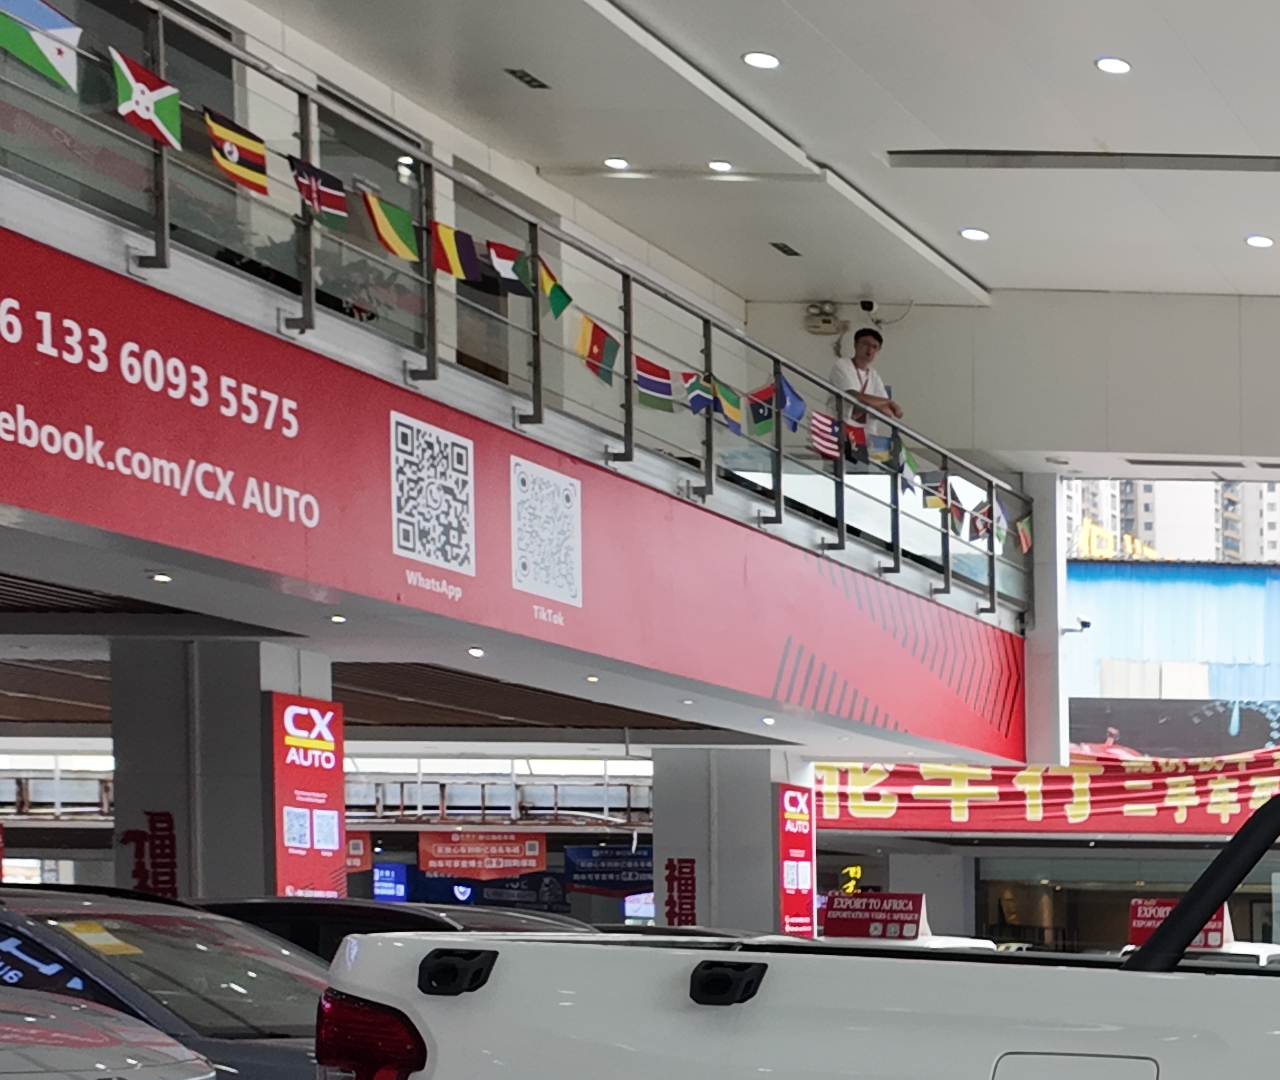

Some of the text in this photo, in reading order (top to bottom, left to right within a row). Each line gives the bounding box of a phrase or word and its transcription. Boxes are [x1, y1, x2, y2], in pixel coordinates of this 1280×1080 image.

[36, 310, 109, 373] 133
[120, 341, 209, 407] 6093
[219, 375, 299, 438] 5575
[242, 477, 320, 528] AUTO
[405, 570, 462, 602] WhatsApp
[532, 605, 565, 626] TikTok
[283, 705, 335, 741] CX
[286, 747, 336, 769] AUTO
[784, 790, 809, 814] CX
[785, 820, 810, 833] AUTO
[833, 897, 867, 909] EXPORT
[868, 898, 881, 909] TO
[881, 899, 913, 911] AFRICA
